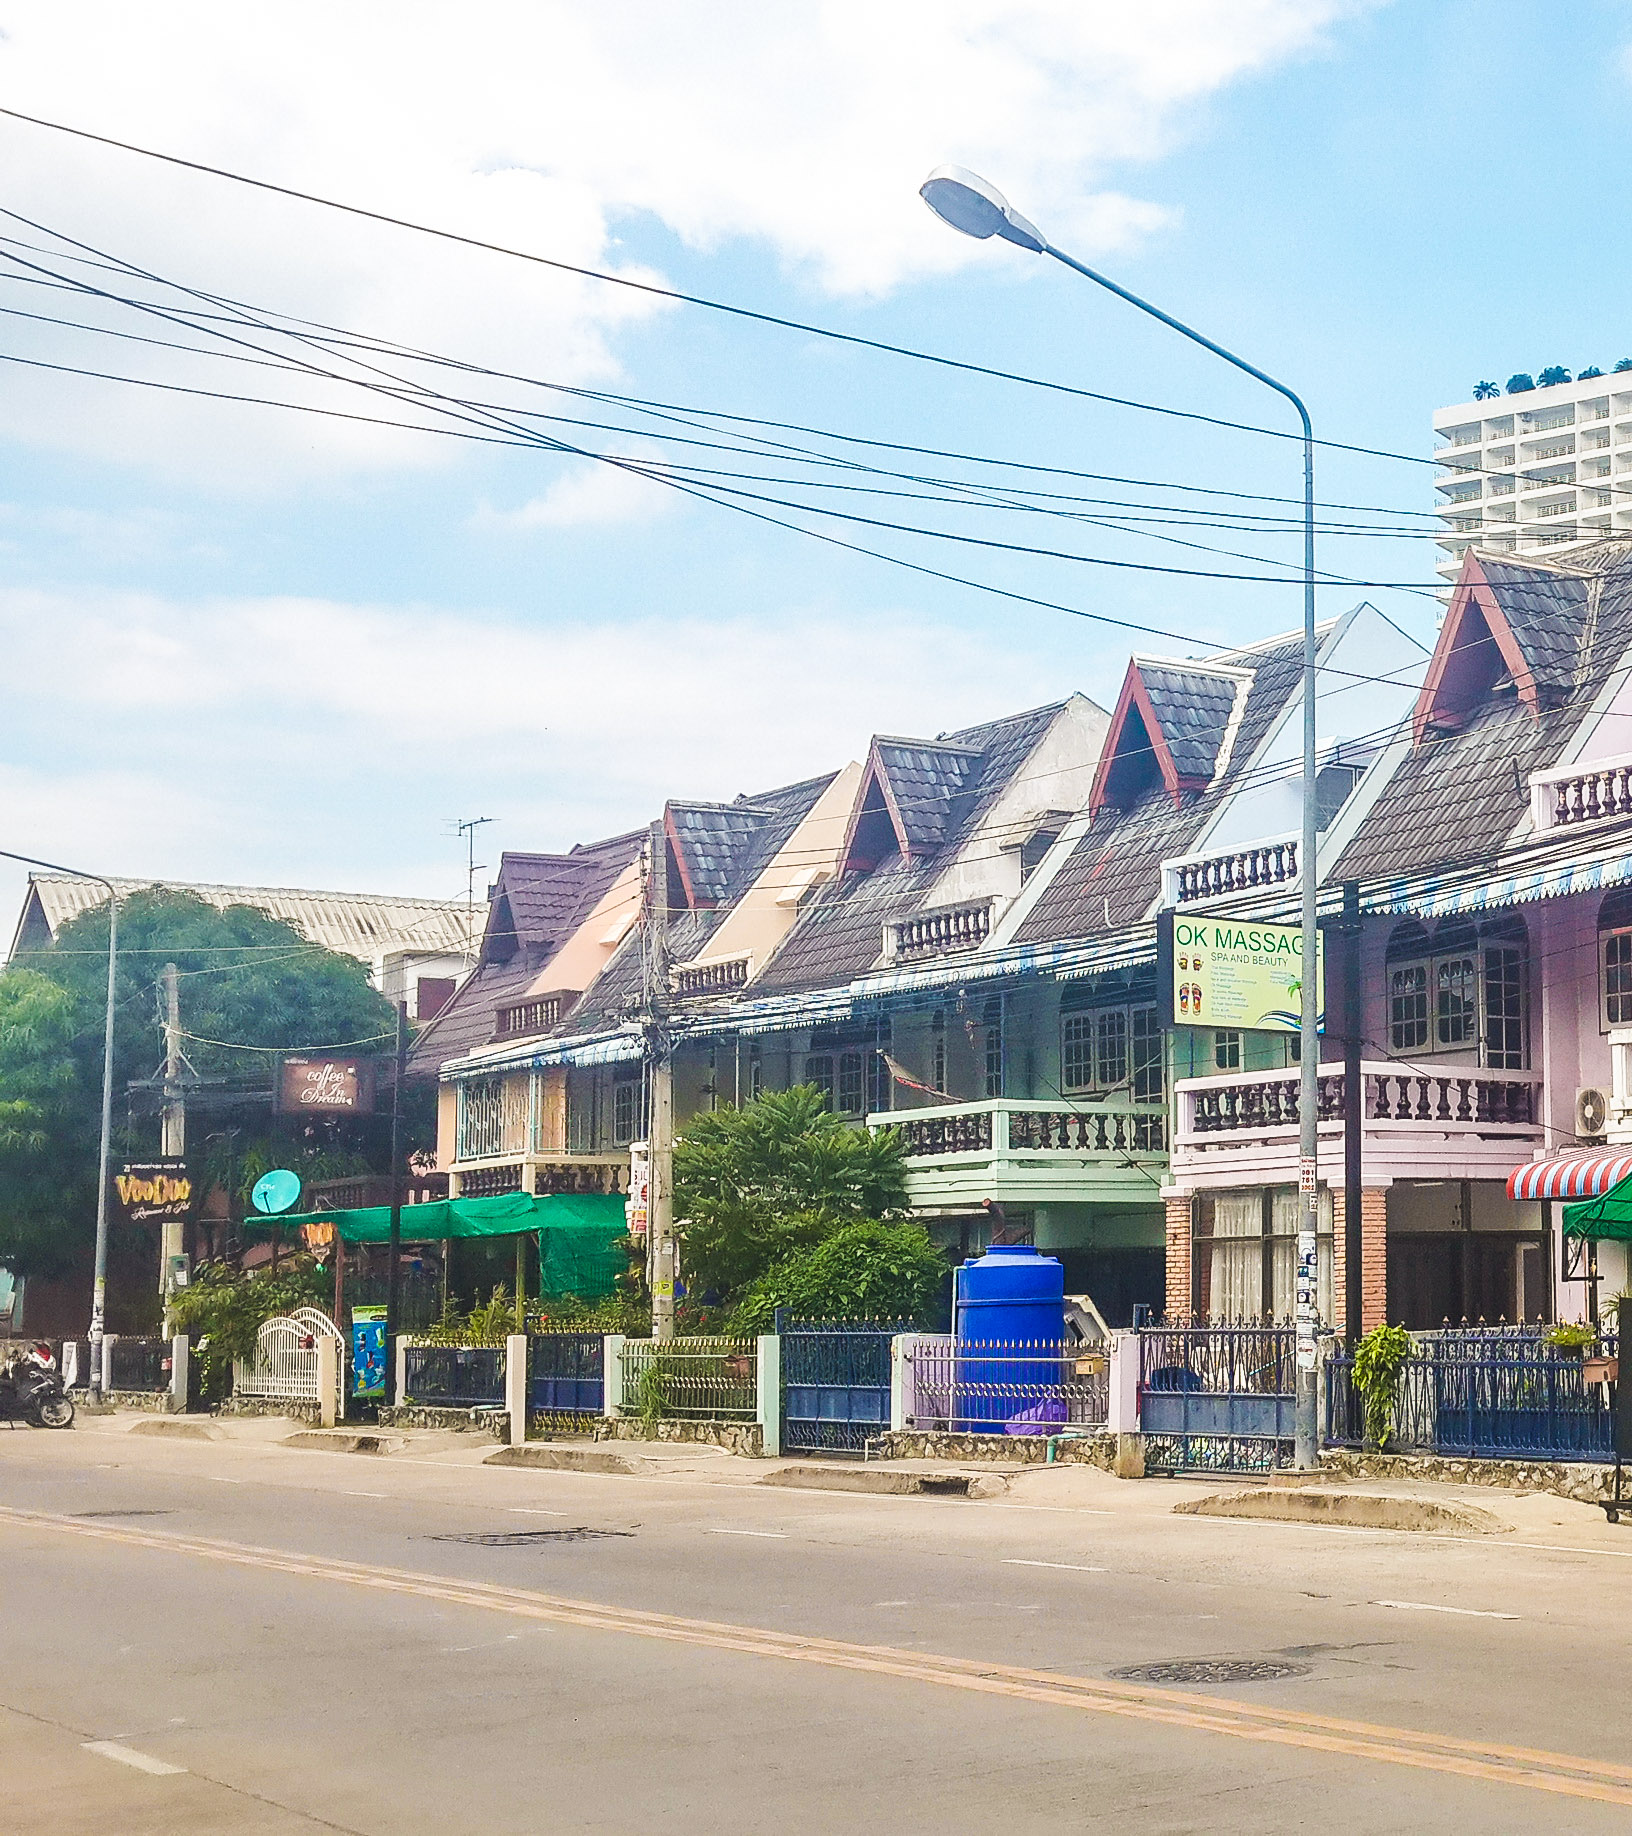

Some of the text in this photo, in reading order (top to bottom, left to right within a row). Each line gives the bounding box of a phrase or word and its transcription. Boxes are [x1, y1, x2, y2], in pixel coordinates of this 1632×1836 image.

[1176, 924, 1208, 948] OK
[1210, 951, 1289, 968] SPA AND BEAUTY
[306, 1063, 345, 1090] coffee
